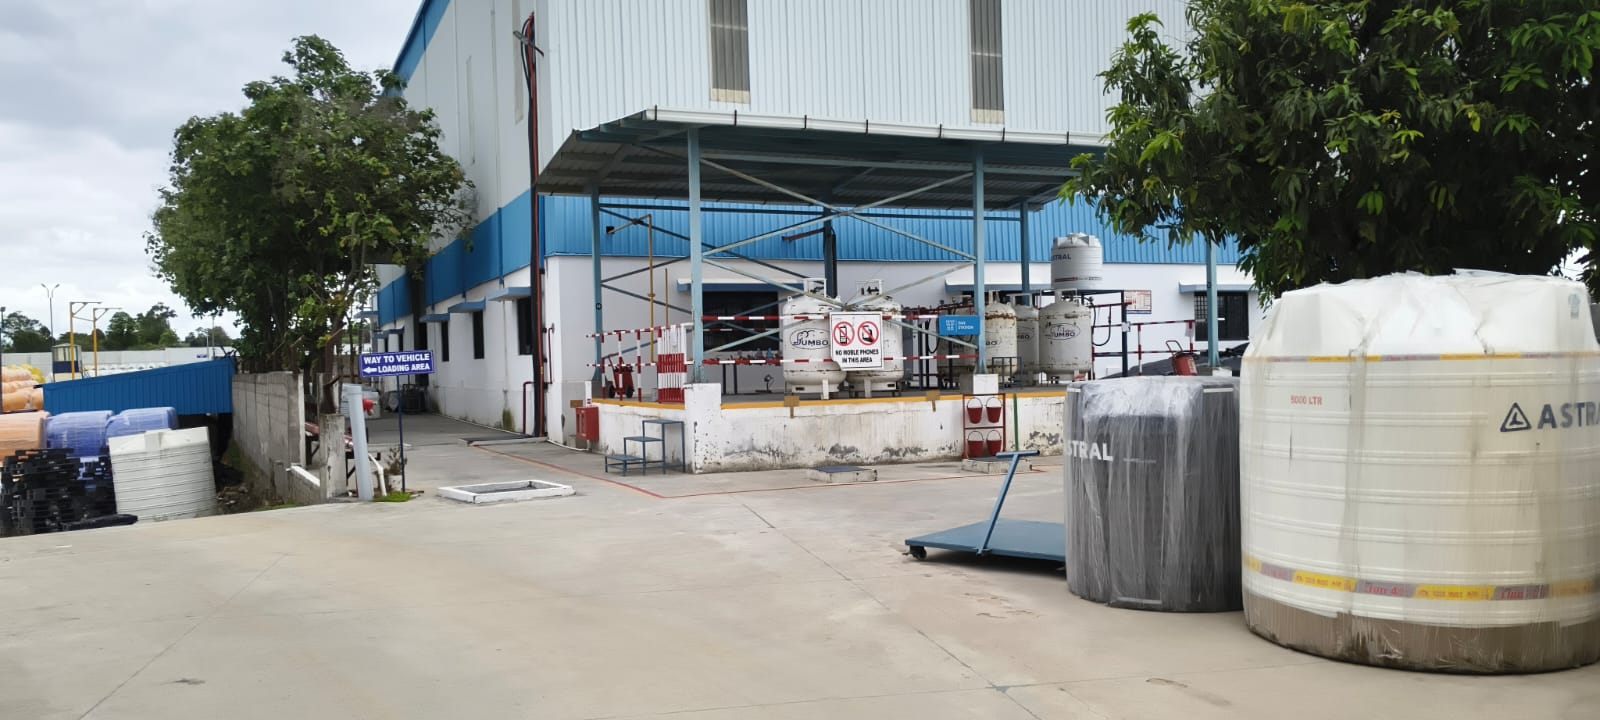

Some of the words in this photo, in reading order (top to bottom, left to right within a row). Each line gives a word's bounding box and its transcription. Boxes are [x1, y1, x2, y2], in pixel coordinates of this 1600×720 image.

[792, 335, 829, 346] JUMBO
[364, 356, 381, 364] WAY
[383, 355, 395, 363] TO
[396, 353, 430, 362] VEHICLE
[378, 365, 409, 373] LOADING
[1308, 395, 1323, 406] LTR
[1066, 440, 1114, 462] STRAL
